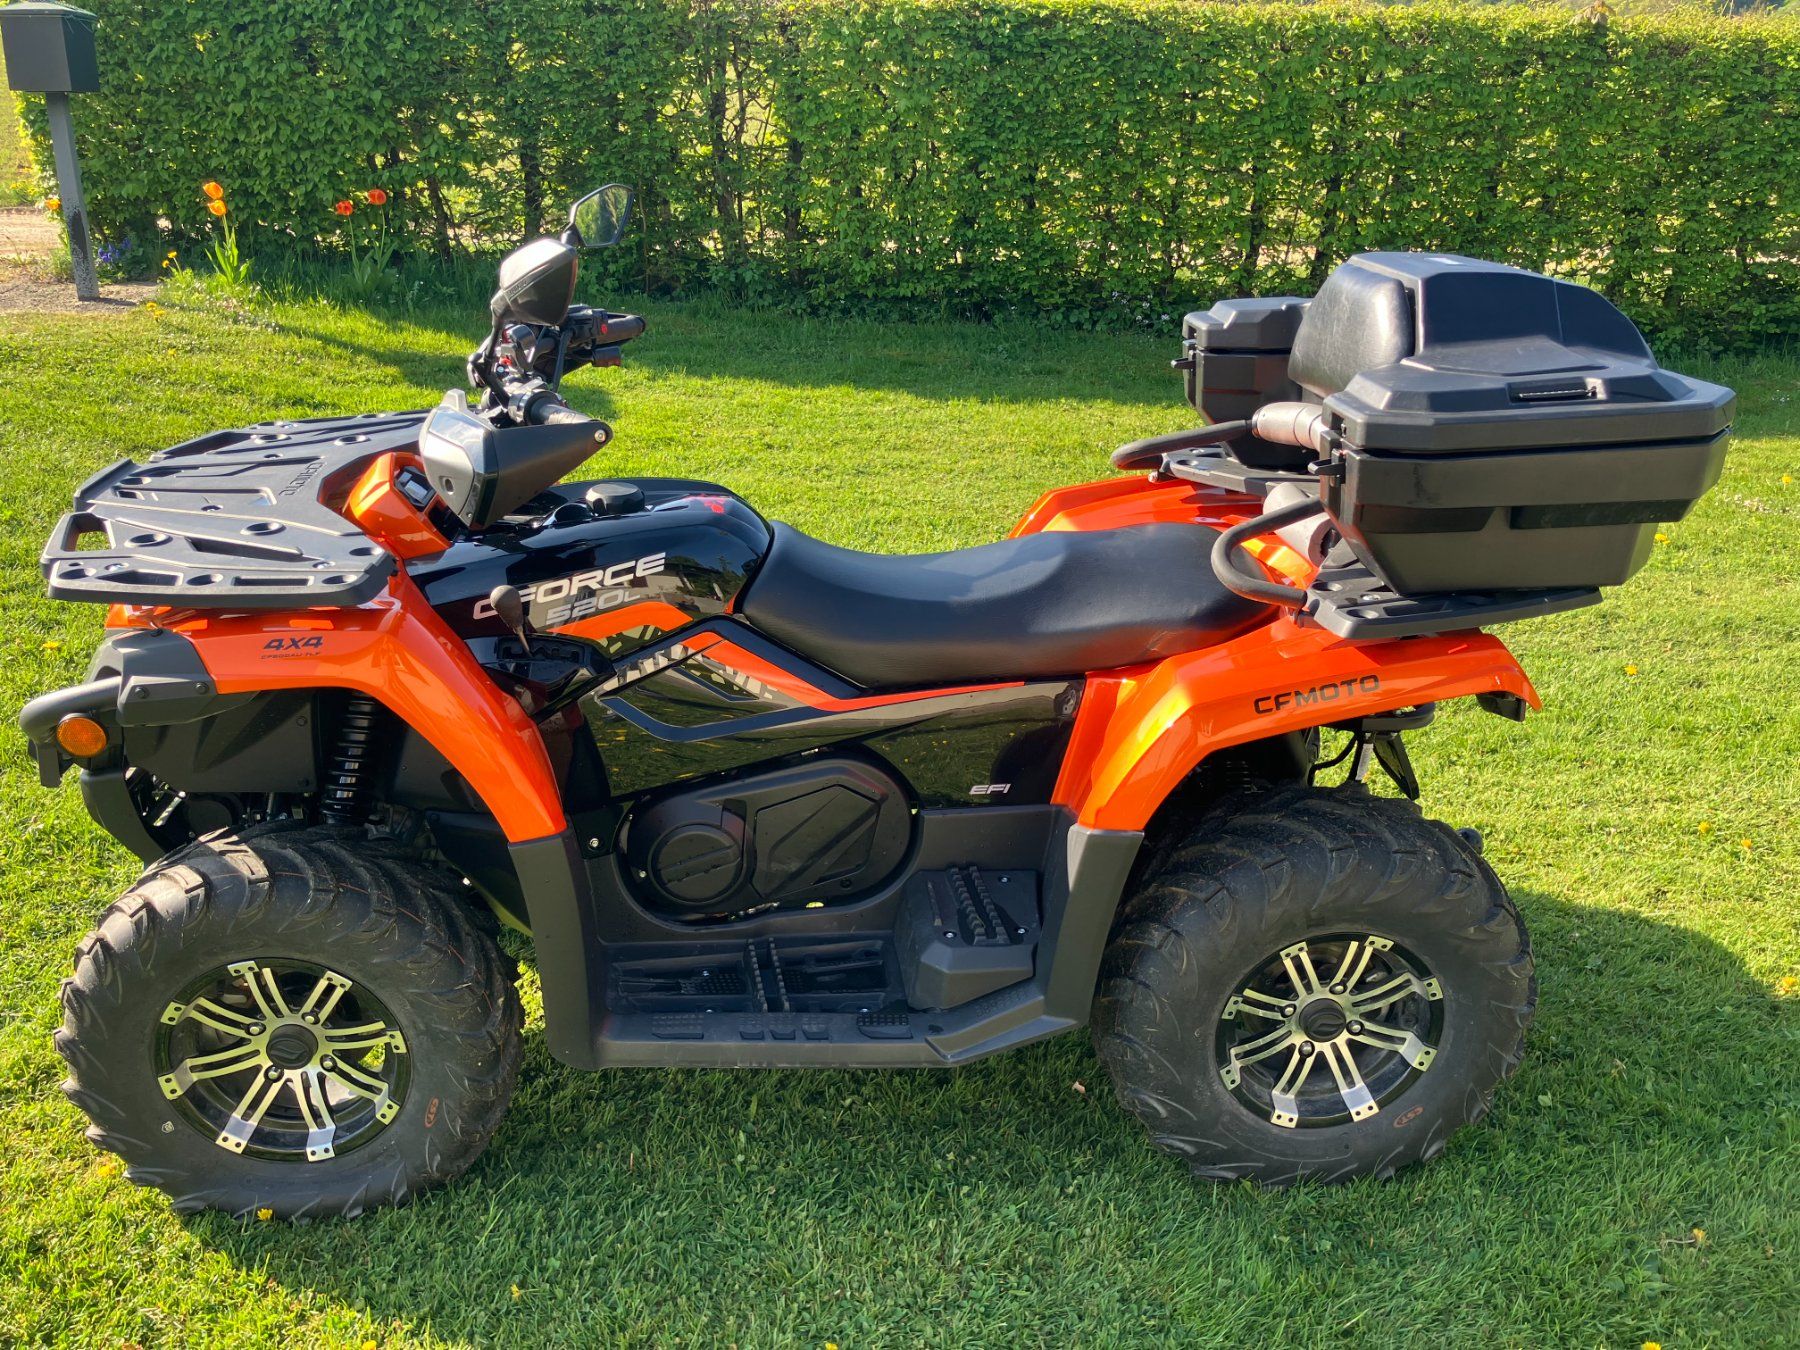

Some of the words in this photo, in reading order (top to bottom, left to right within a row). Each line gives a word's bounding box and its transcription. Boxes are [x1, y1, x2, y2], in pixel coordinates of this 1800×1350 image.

[546, 589, 641, 625] 520L
[1254, 674, 1380, 714] CFMOTO
[969, 783, 1011, 795] EFI
